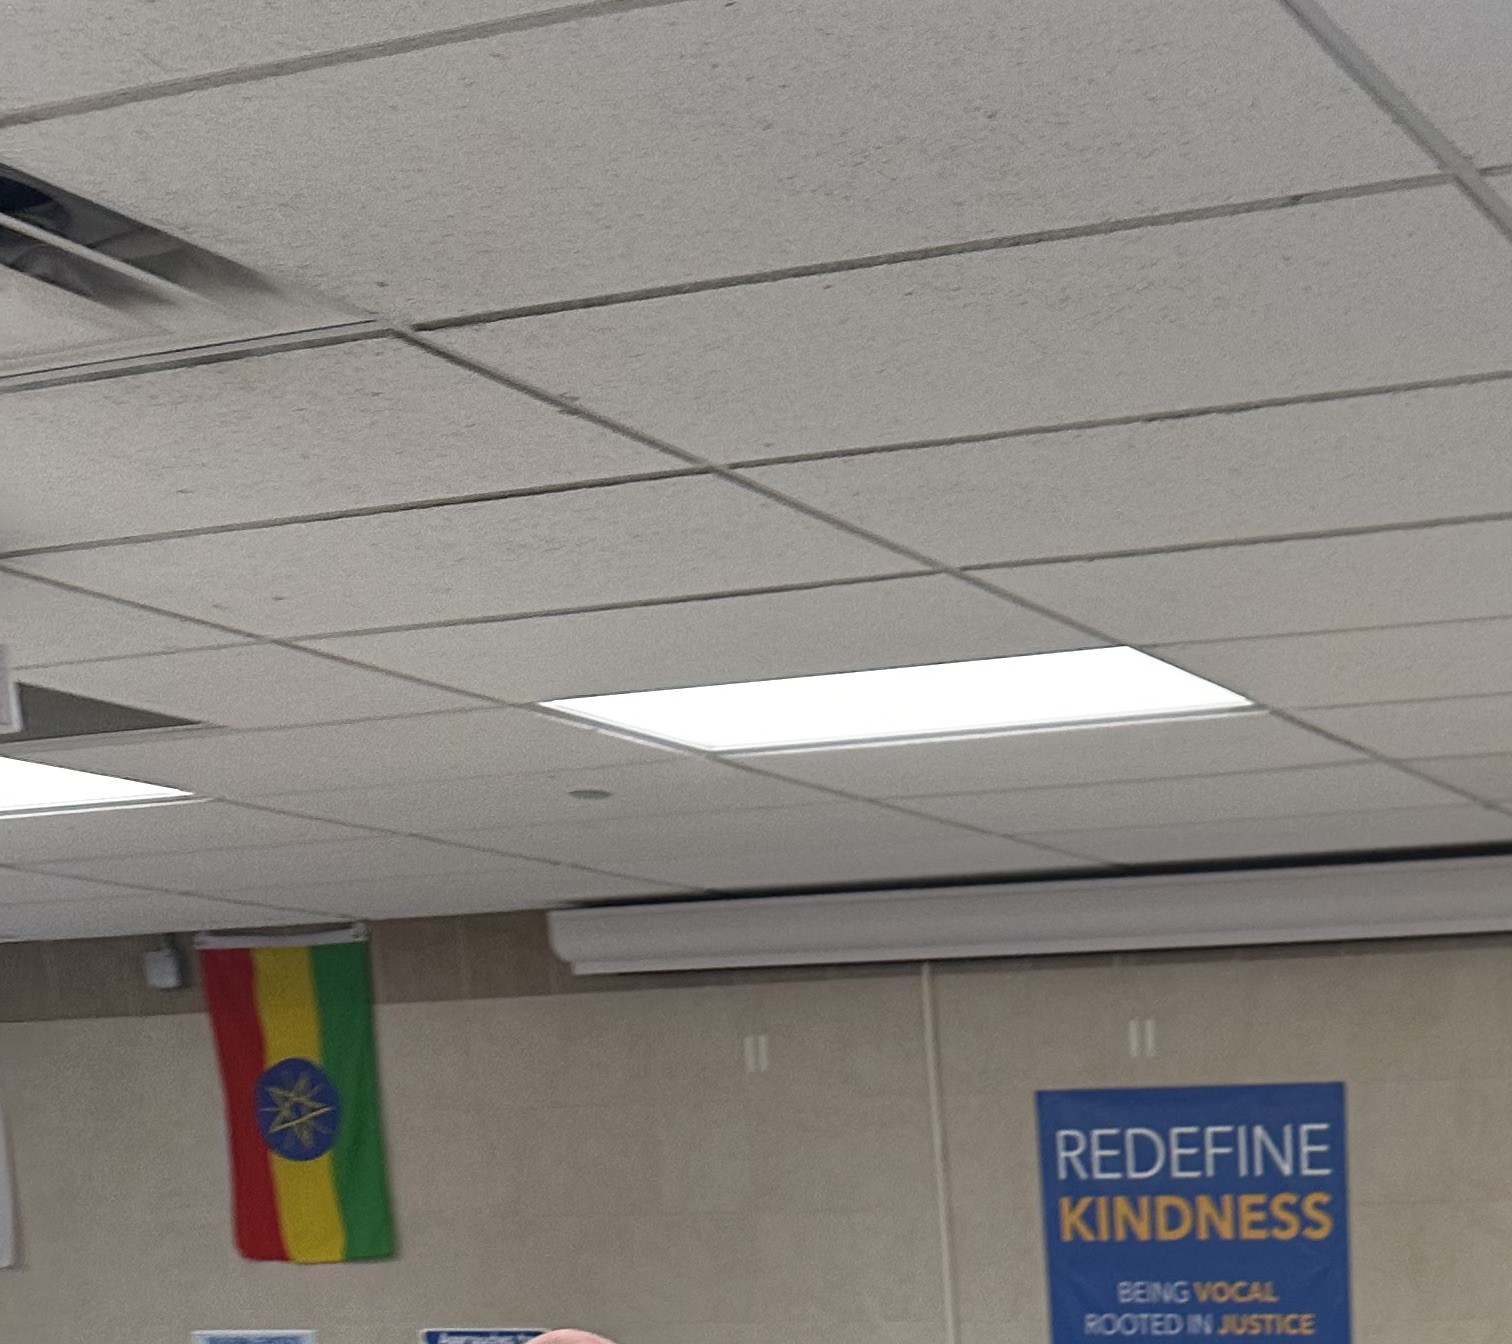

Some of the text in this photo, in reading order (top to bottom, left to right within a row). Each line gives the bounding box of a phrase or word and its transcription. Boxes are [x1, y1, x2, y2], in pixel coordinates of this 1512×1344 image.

[1056, 1122, 1333, 1181] REDEFINE
[1059, 1191, 1334, 1242] KINDNESS
[1117, 1281, 1280, 1303] BEING VOCAL
[1084, 1312, 1316, 1336] ROOTED IN JUSTICE
